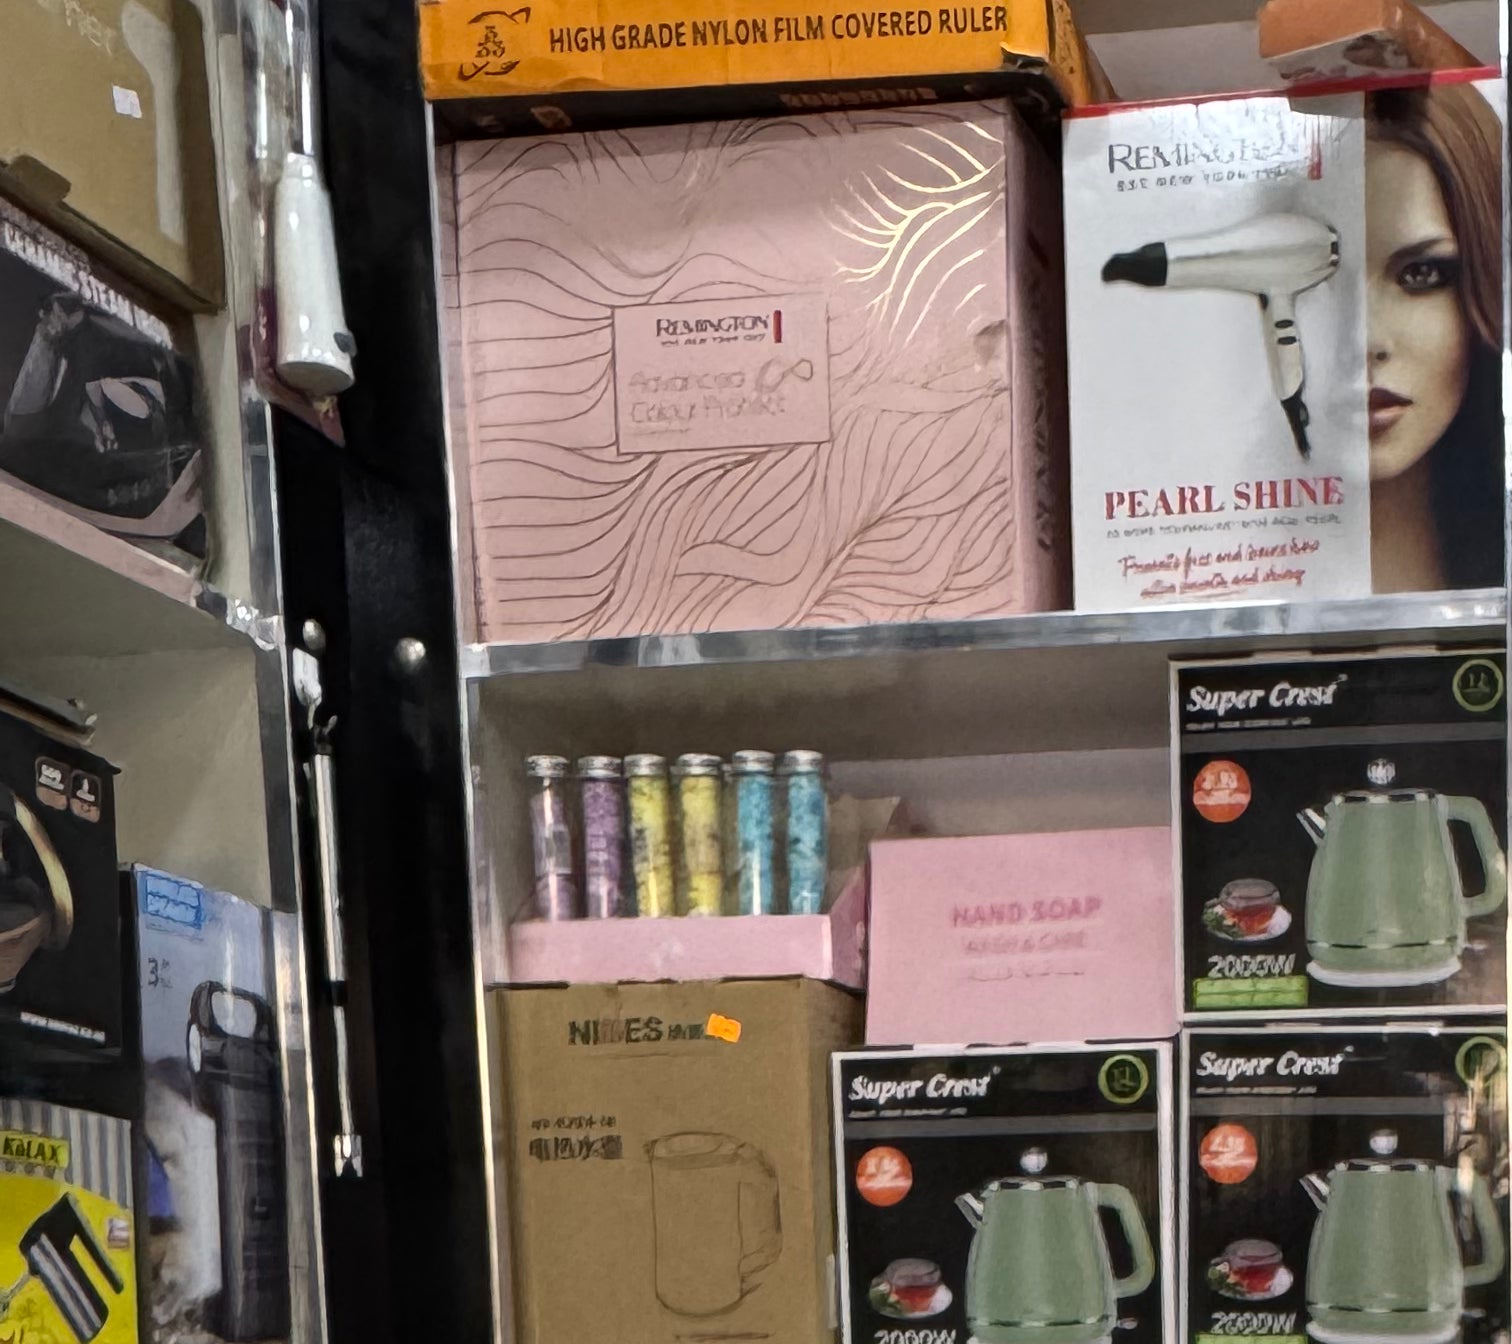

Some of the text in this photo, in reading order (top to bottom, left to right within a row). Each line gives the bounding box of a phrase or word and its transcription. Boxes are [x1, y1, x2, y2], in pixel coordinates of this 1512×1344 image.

[550, 5, 1008, 53] HIGH GRADE NYLON FILM COVERED RULER
[1105, 476, 1345, 520] PEARL SHINE
[1186, 685, 1265, 716] Super
[568, 1016, 663, 1045] NIES
[1196, 1051, 1275, 1082] Super
[850, 1074, 924, 1105] Super
